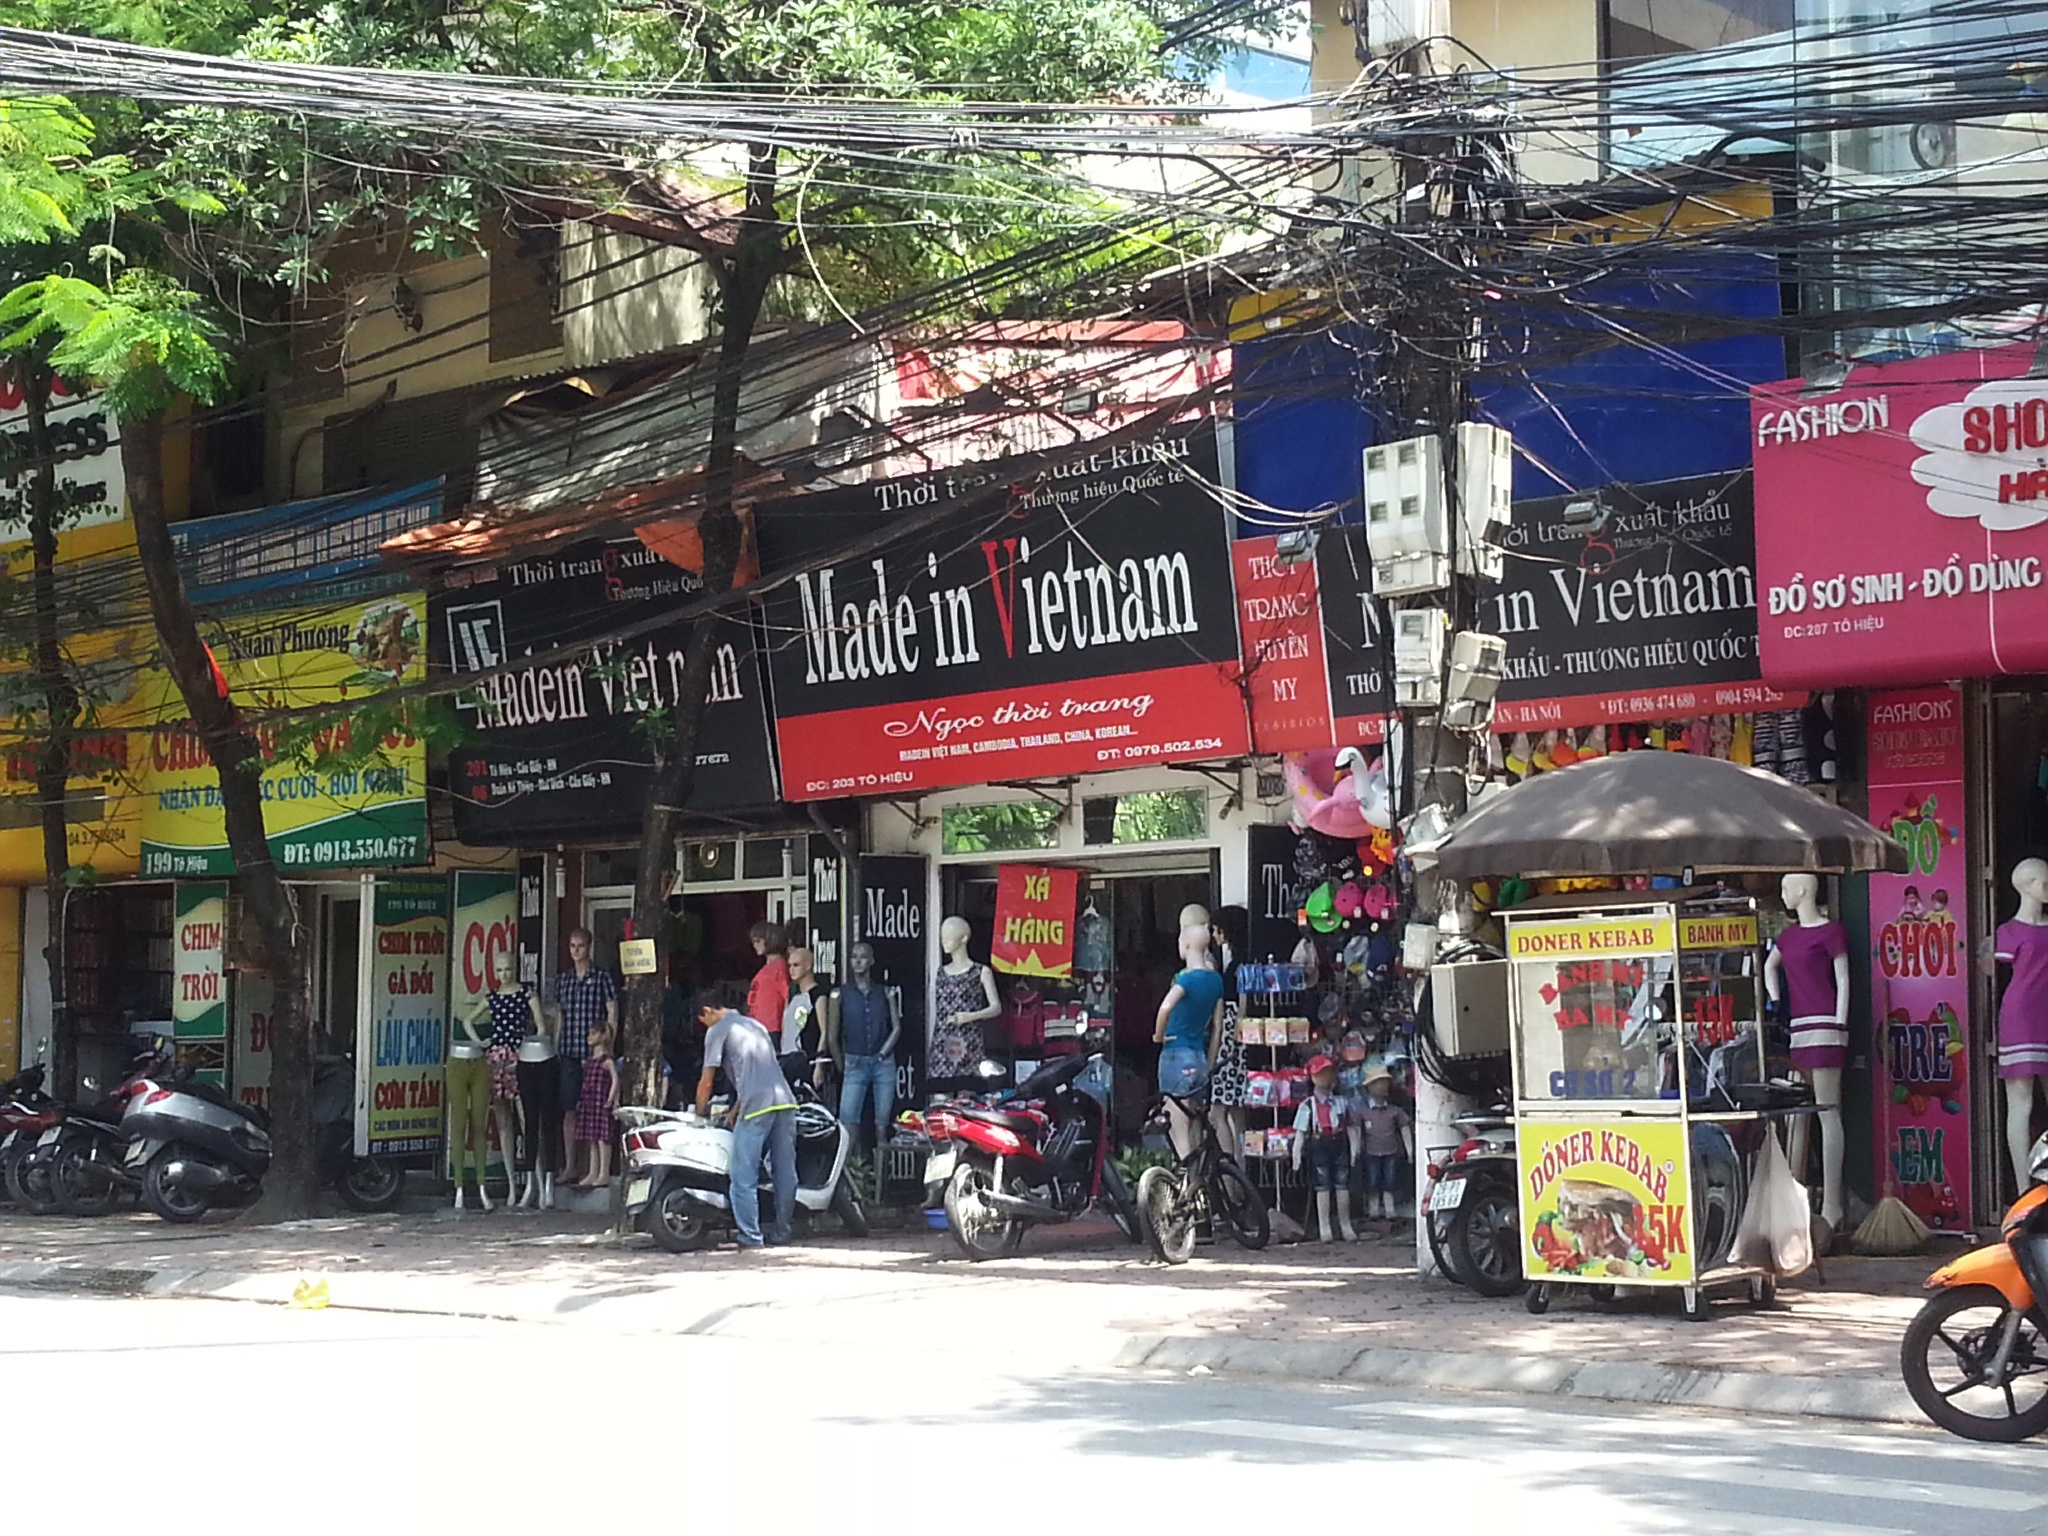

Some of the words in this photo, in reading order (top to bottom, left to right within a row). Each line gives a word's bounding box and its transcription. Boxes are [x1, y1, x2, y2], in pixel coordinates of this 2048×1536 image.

[1757, 394, 1890, 448] FASHION
[874, 472, 939, 512] Thời
[1083, 478, 1118, 500] hiệu
[1122, 466, 1163, 494] Quốc
[508, 562, 555, 587] Thời
[1769, 573, 1805, 615] ĐỒ
[1812, 577, 1846, 609] SƠ
[1851, 572, 1904, 606] SINH
[1923, 553, 1963, 598] ĐỒ
[1969, 555, 2041, 593] DÙNG
[795, 558, 918, 685] Made
[928, 551, 980, 668] in
[981, 536, 1199, 659] Vietnam
[1549, 562, 1757, 627] Vietnam
[280, 622, 351, 655] Phương
[1832, 616, 1851, 633] TÔ
[1854, 615, 1885, 632] HIỆU
[1255, 629, 1310, 662] HUYỀN
[1502, 646, 1551, 681] KHẨU
[1563, 645, 1640, 676] THƯƠNG
[1645, 637, 1688, 669] HIỆU
[1692, 627, 1748, 661] QUỐC
[1272, 677, 1298, 702] MY
[1346, 666, 1383, 696] THỜ
[883, 708, 984, 742] Ngọc
[992, 700, 1052, 724] thời
[1060, 693, 1155, 719] trang
[1521, 704, 1538, 722] HÀ
[1540, 700, 1562, 721] NỘI
[1608, 697, 1629, 716] ĐT:
[1656, 691, 1676, 711] 474
[1873, 700, 1953, 725] FASHIONS
[1097, 748, 1122, 762] ĐT:
[1124, 737, 1223, 760] 0979.502.534
[466, 760, 488, 778] 201
[832, 776, 856, 790] 203
[858, 768, 877, 786] TÔ
[880, 770, 914, 789] HIỆU
[159, 780, 202, 814] NHẬN
[146, 852, 172, 875] 199
[284, 842, 311, 865] ĐT:
[314, 835, 418, 863] 0913.550.677
[1023, 867, 1051, 902] XẢ
[865, 887, 921, 939] Made
[1004, 912, 1064, 946] HÀNG
[181, 923, 221, 951] CHIM
[378, 931, 412, 955] CHIM
[1517, 930, 1583, 953] DONER
[1588, 928, 1655, 947] KEBAB
[1687, 924, 1726, 944] BANH
[1728, 923, 1748, 942] MY
[1879, 915, 1958, 979] CHƠI
[463, 914, 518, 995] CƠ
[181, 965, 219, 1001] TRỜI
[388, 964, 408, 995] GÀ
[406, 1008, 443, 1066] CHÁO
[1887, 1002, 1953, 1082] TRẺ
[1528, 1130, 1595, 1202] DÖNER
[1599, 1129, 1669, 1205] KEBAB
[1897, 1126, 1946, 1184] EM
